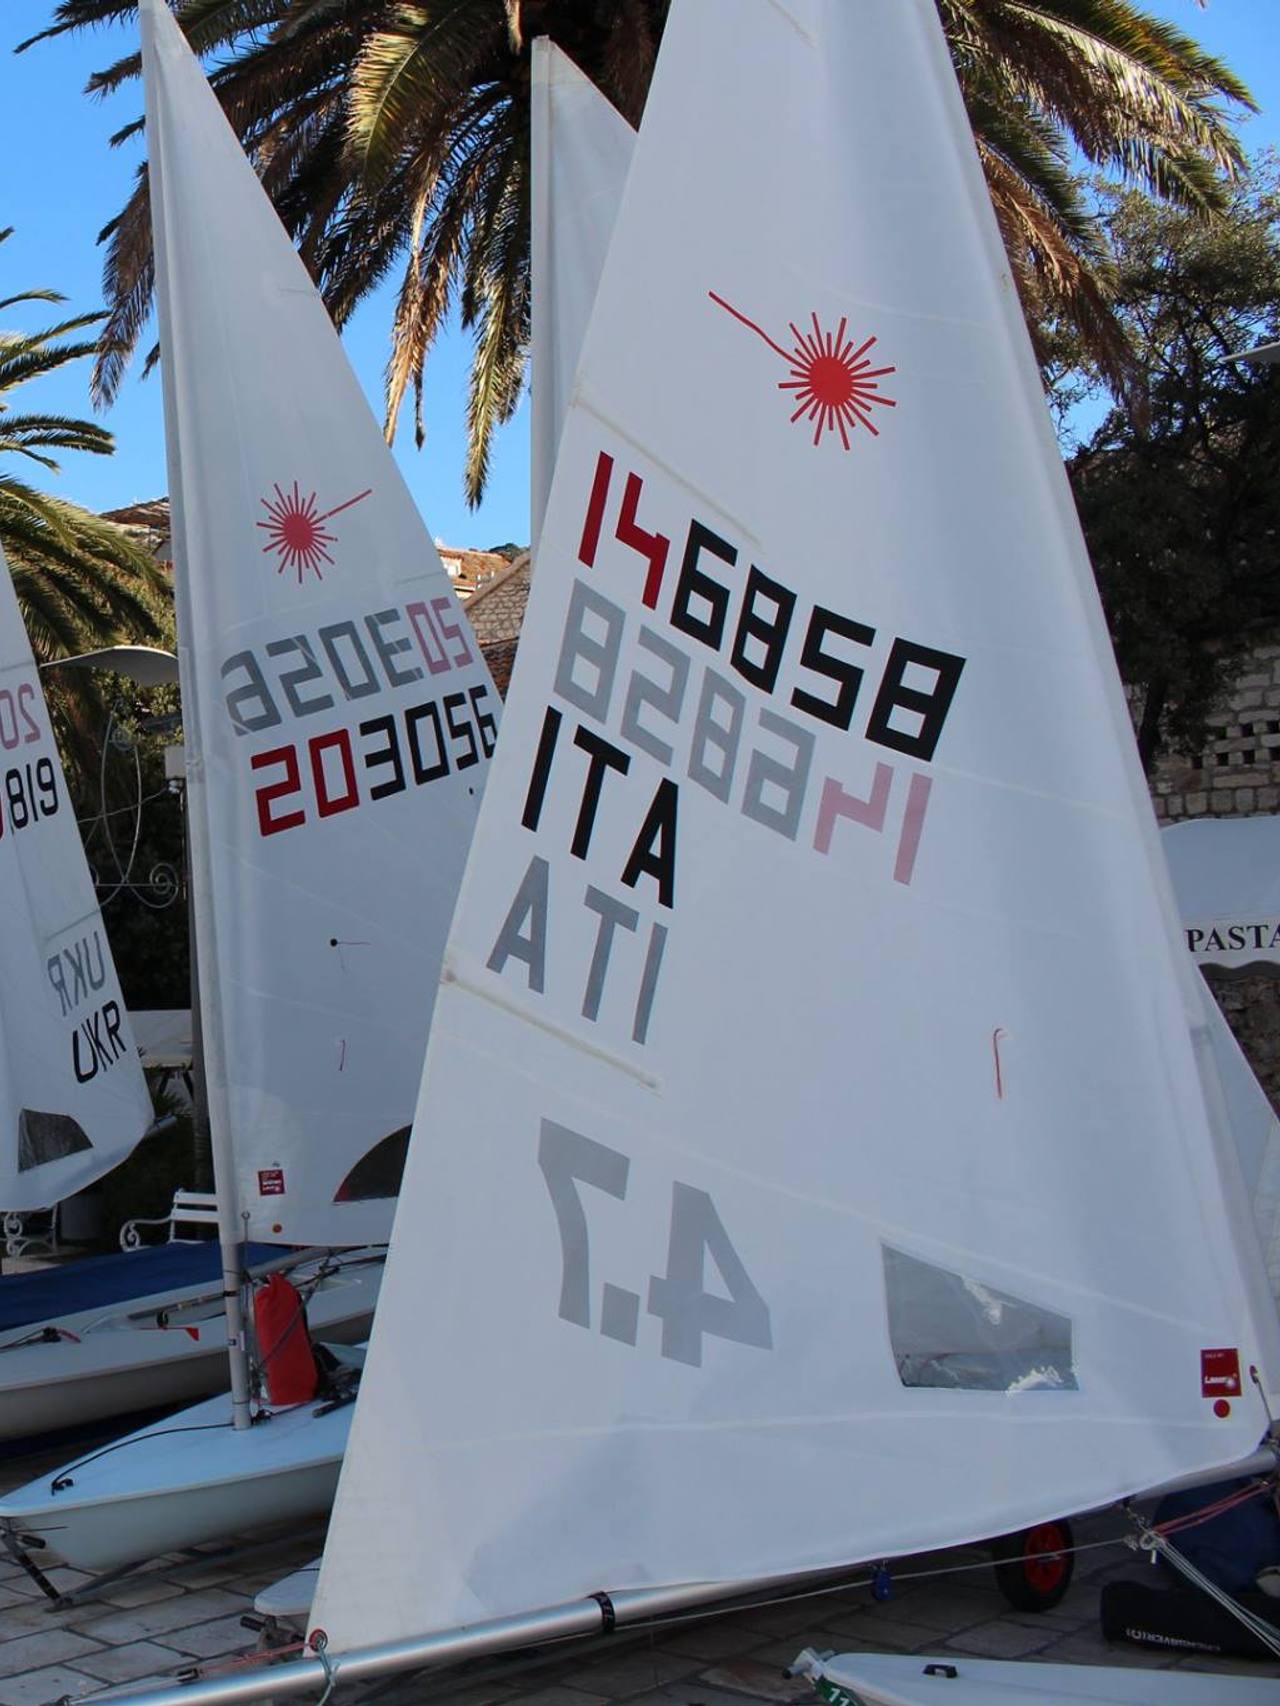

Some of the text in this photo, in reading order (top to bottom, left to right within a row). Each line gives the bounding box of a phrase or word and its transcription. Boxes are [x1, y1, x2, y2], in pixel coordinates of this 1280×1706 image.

[578, 450, 966, 762] 146858
[250, 684, 497, 837] 203056
[521, 704, 679, 909] ITA
[73, 1000, 128, 1084] UKR
